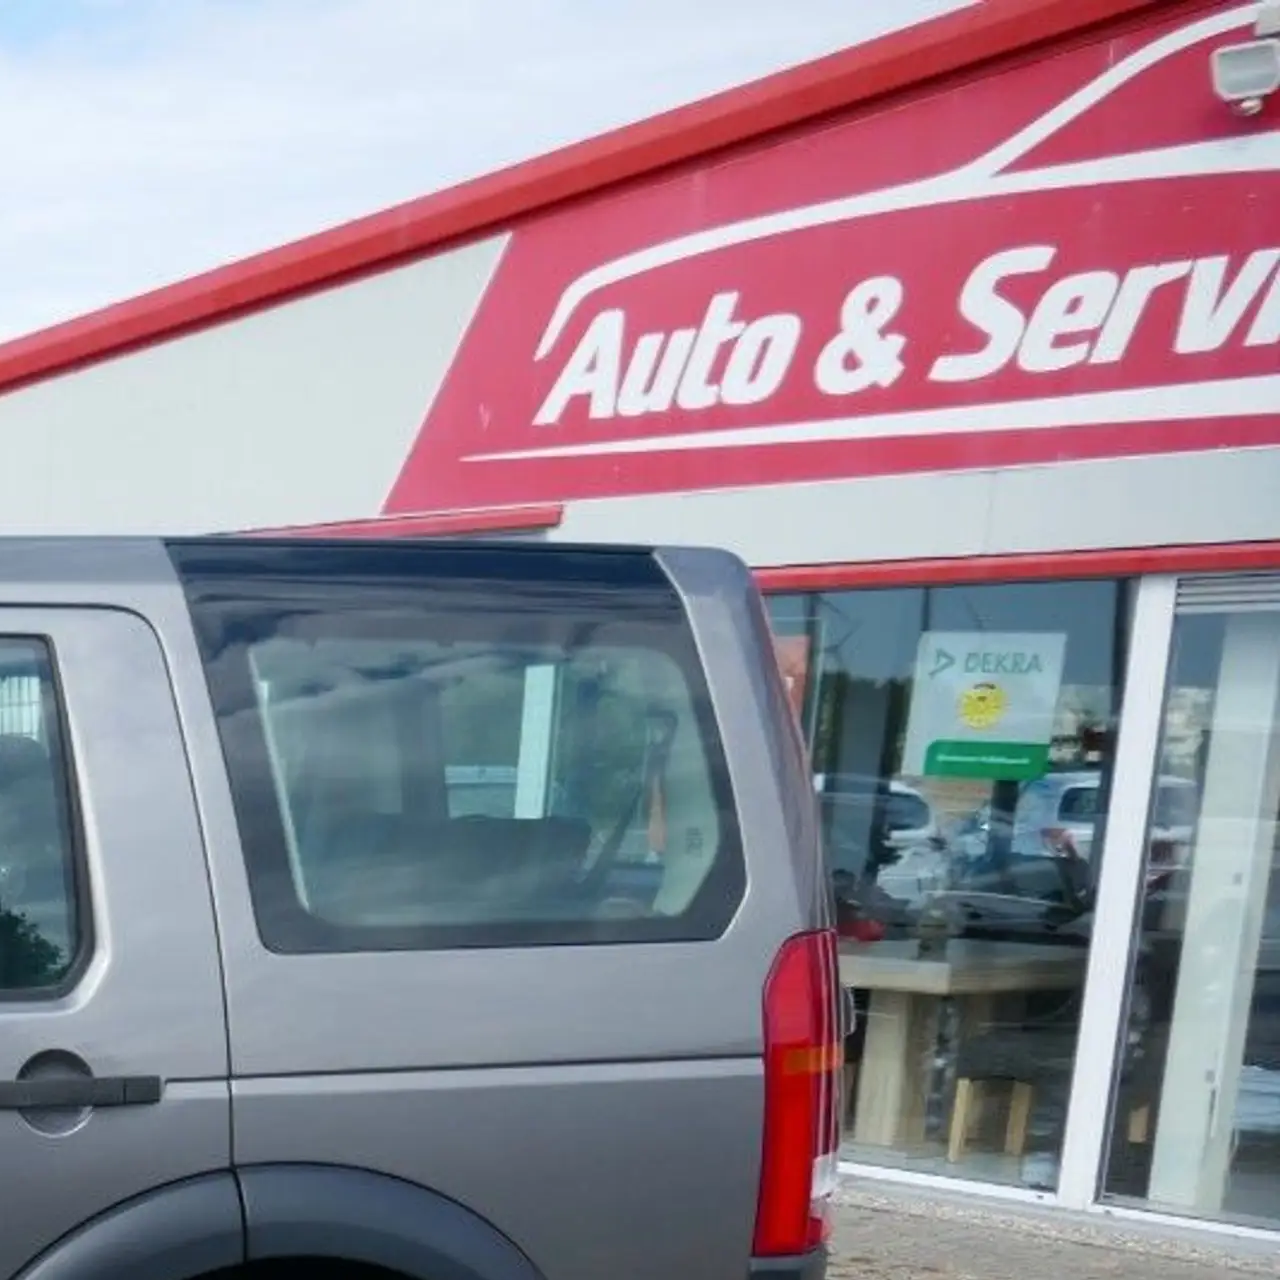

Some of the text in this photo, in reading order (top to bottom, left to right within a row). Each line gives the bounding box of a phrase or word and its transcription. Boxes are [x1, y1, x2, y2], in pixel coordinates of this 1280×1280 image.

[532, 290, 802, 426] Auto
[814, 276, 907, 396] &
[963, 651, 1043, 674] DEKRA
